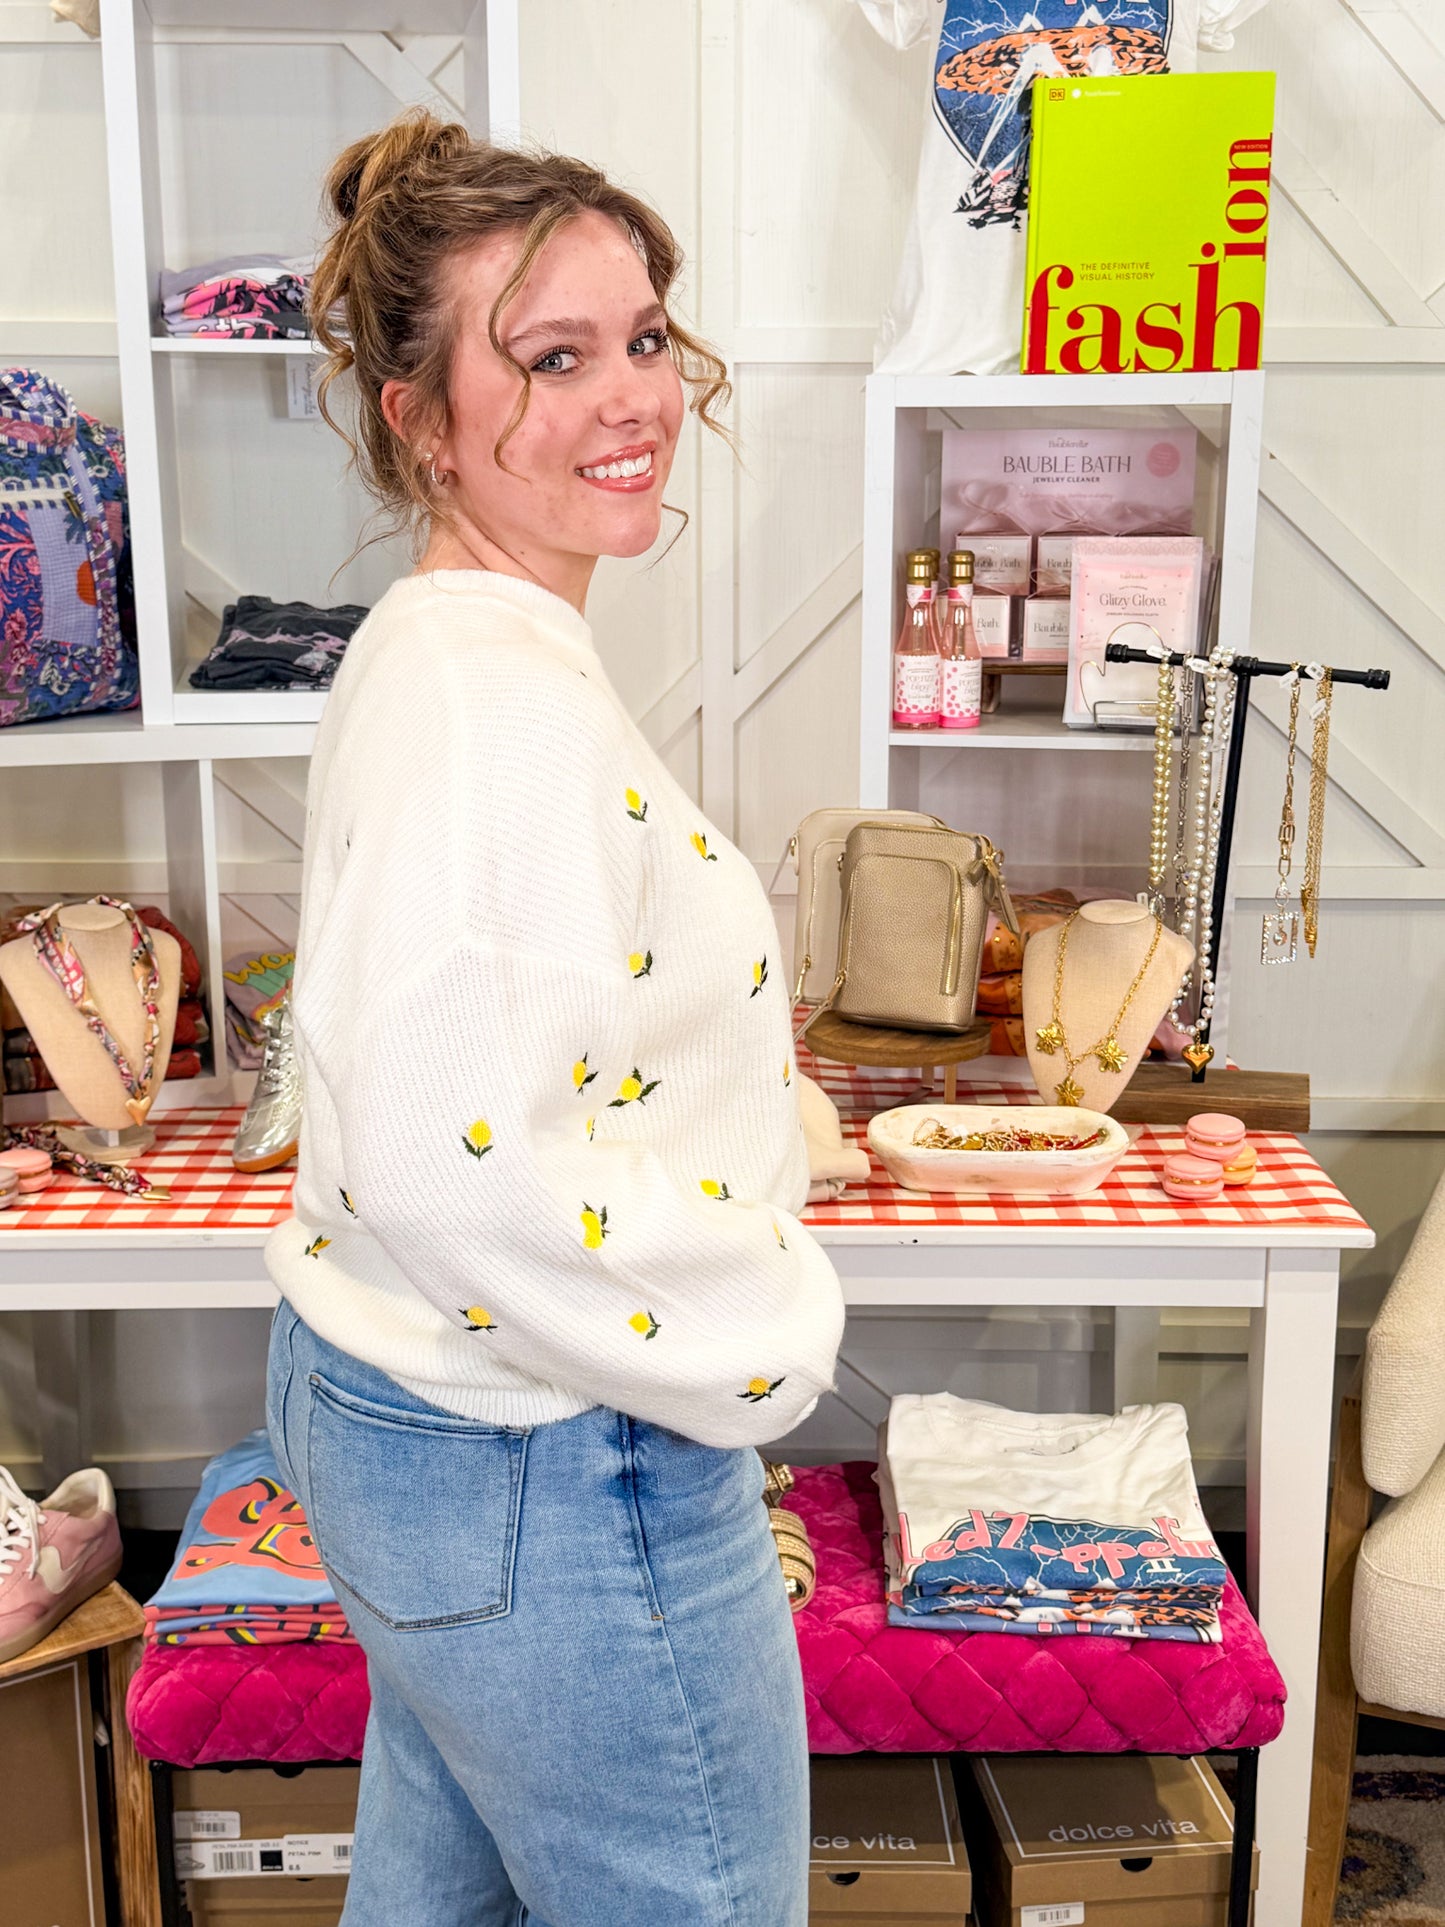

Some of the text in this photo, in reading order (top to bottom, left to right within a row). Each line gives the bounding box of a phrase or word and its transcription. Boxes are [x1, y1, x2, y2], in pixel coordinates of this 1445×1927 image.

[1080, 261, 1151, 272] THE DEFINITIVE
[1080, 271, 1155, 281] VISUAL HISTORY
[1003, 455, 1076, 474] BAUBLE
[1081, 455, 1132, 473] BATH
[1032, 476, 1101, 485] JEWELRY CLEANER
[1047, 557, 1072, 568] Baub
[1099, 592, 1131, 610] Glitzy
[1033, 621, 1069, 633] Bauble
[899, 1509, 992, 1565] Led
[1146, 1557, 1181, 1573] II
[1048, 1819, 1200, 1842] dolce vita
[860, 1832, 917, 1850] vita
